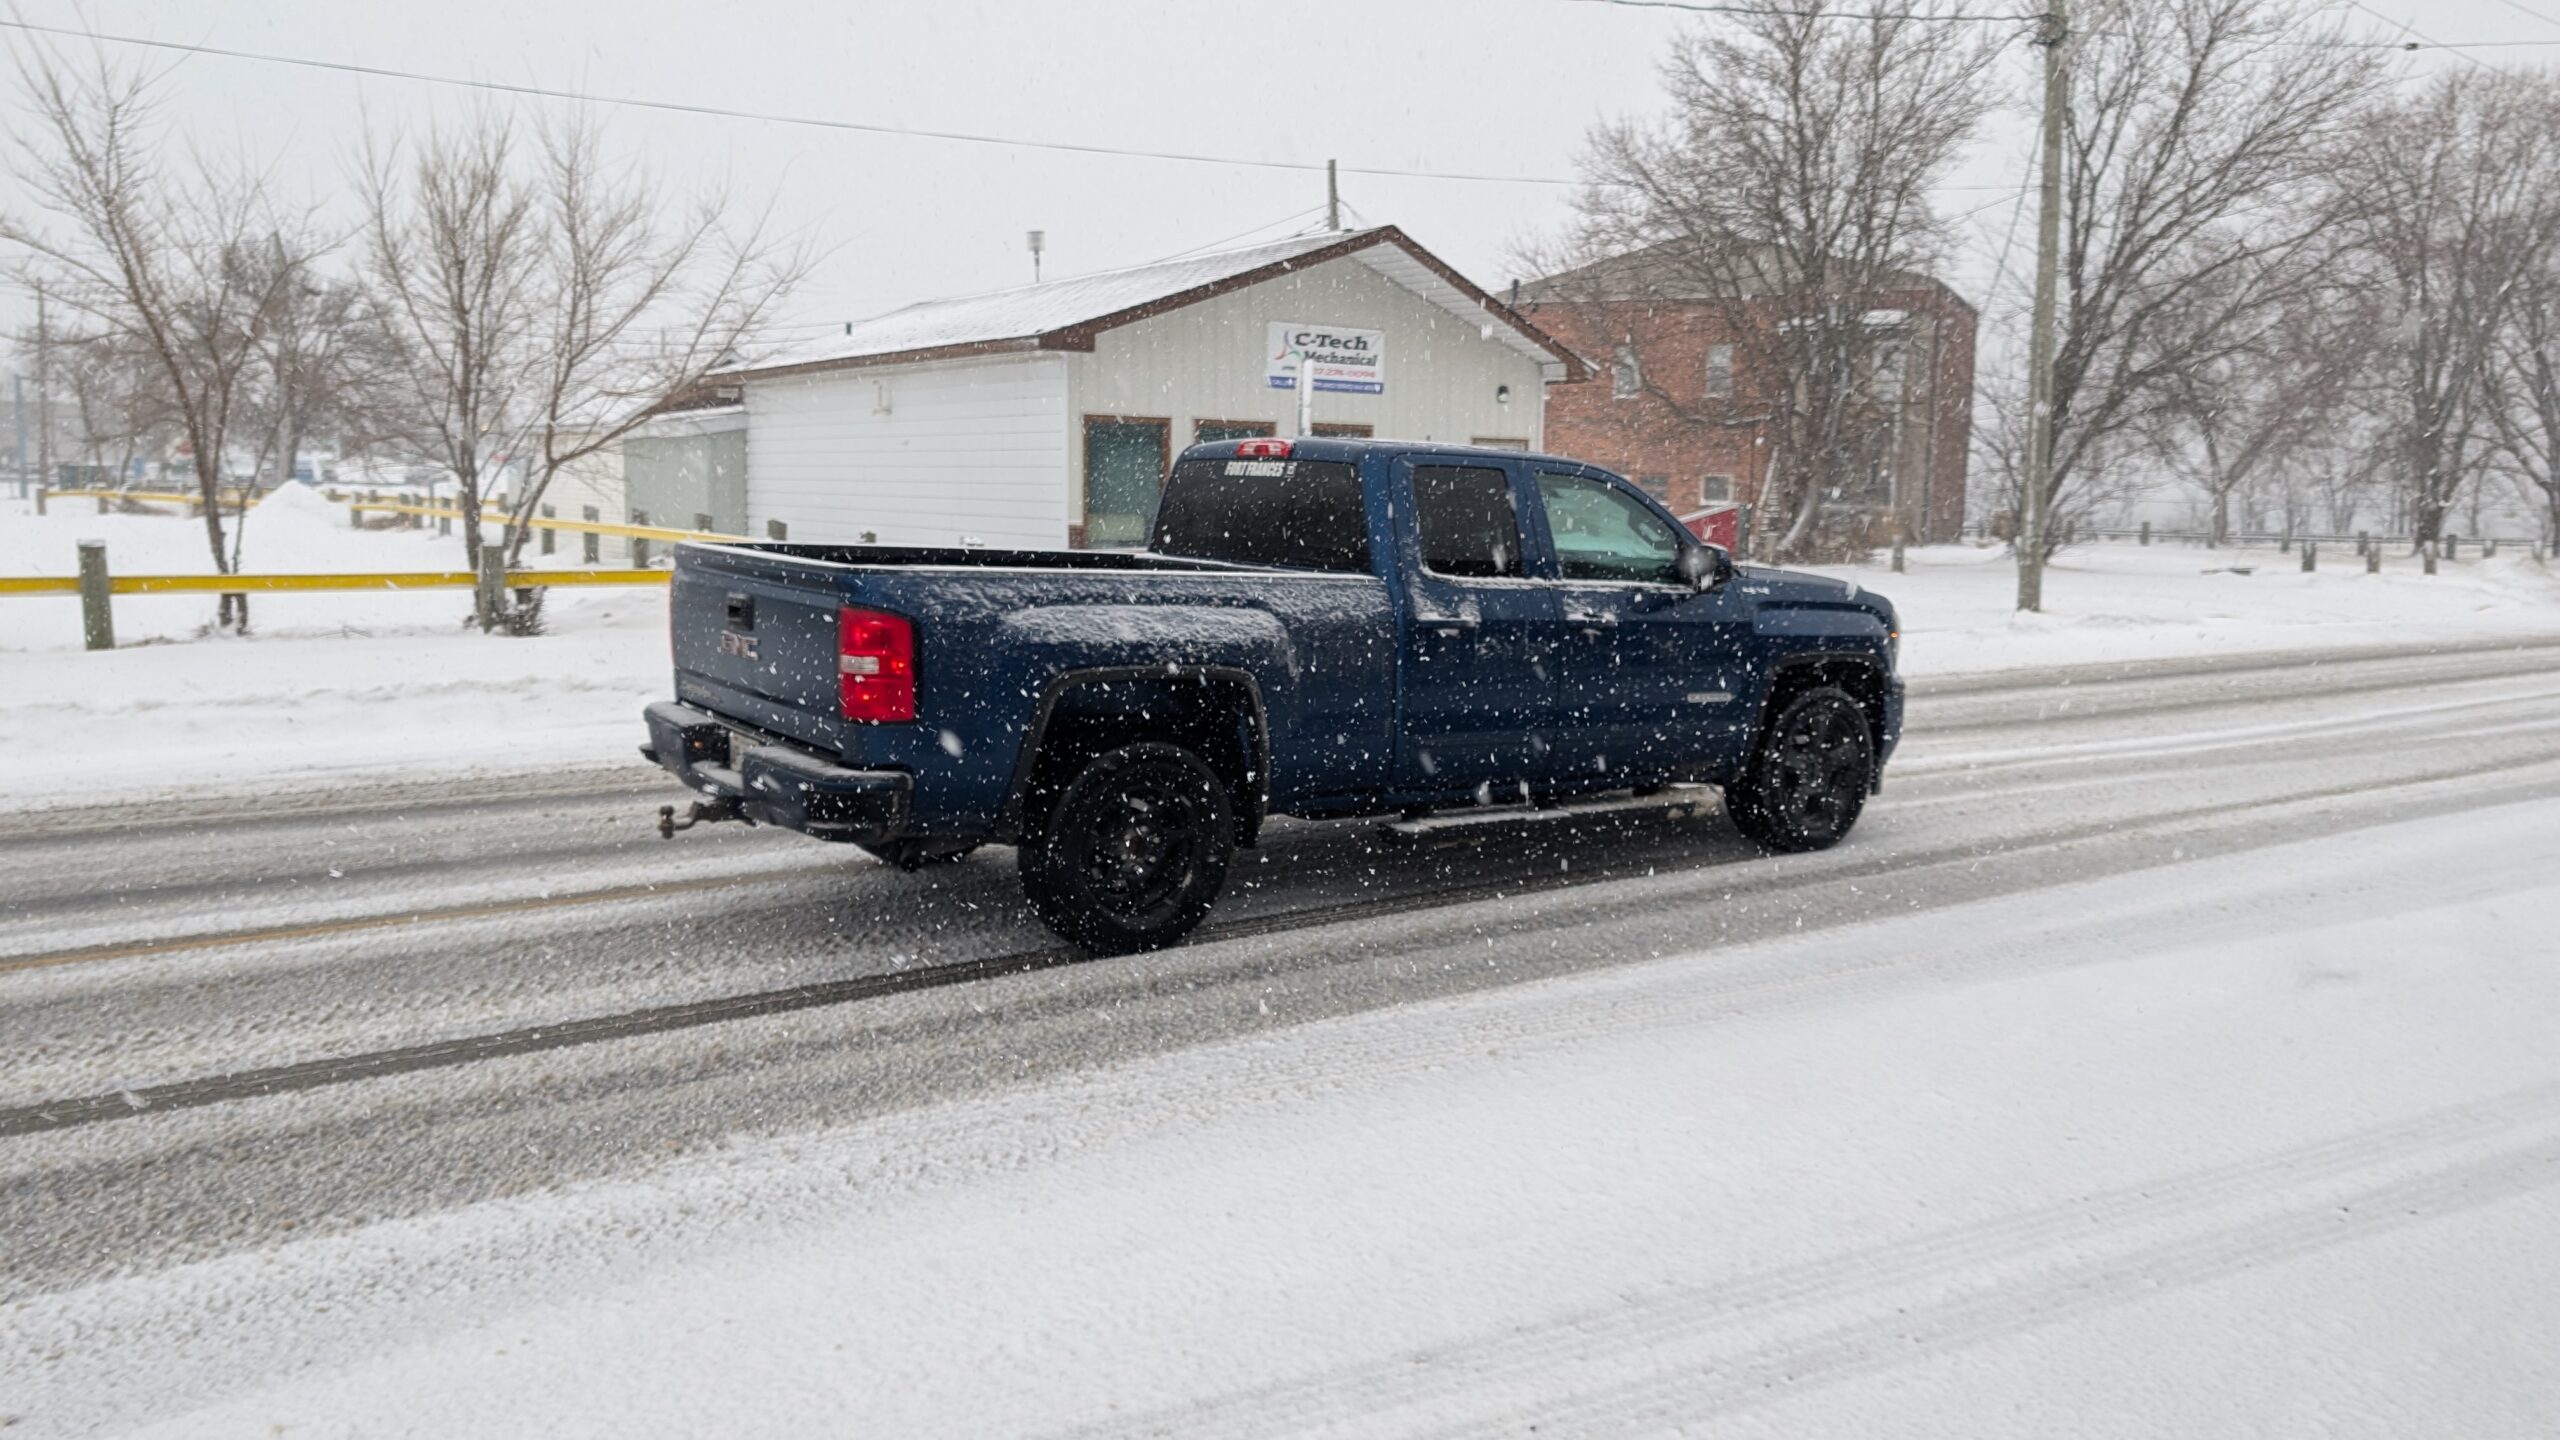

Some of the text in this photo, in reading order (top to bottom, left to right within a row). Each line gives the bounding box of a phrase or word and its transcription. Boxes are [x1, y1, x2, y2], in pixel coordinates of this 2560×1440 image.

[1295, 332, 1368, 351] C-Tech
[1303, 350, 1378, 367] Mechanical
[1224, 461, 1247, 476] FORT
[1245, 461, 1286, 477] FRANCES
